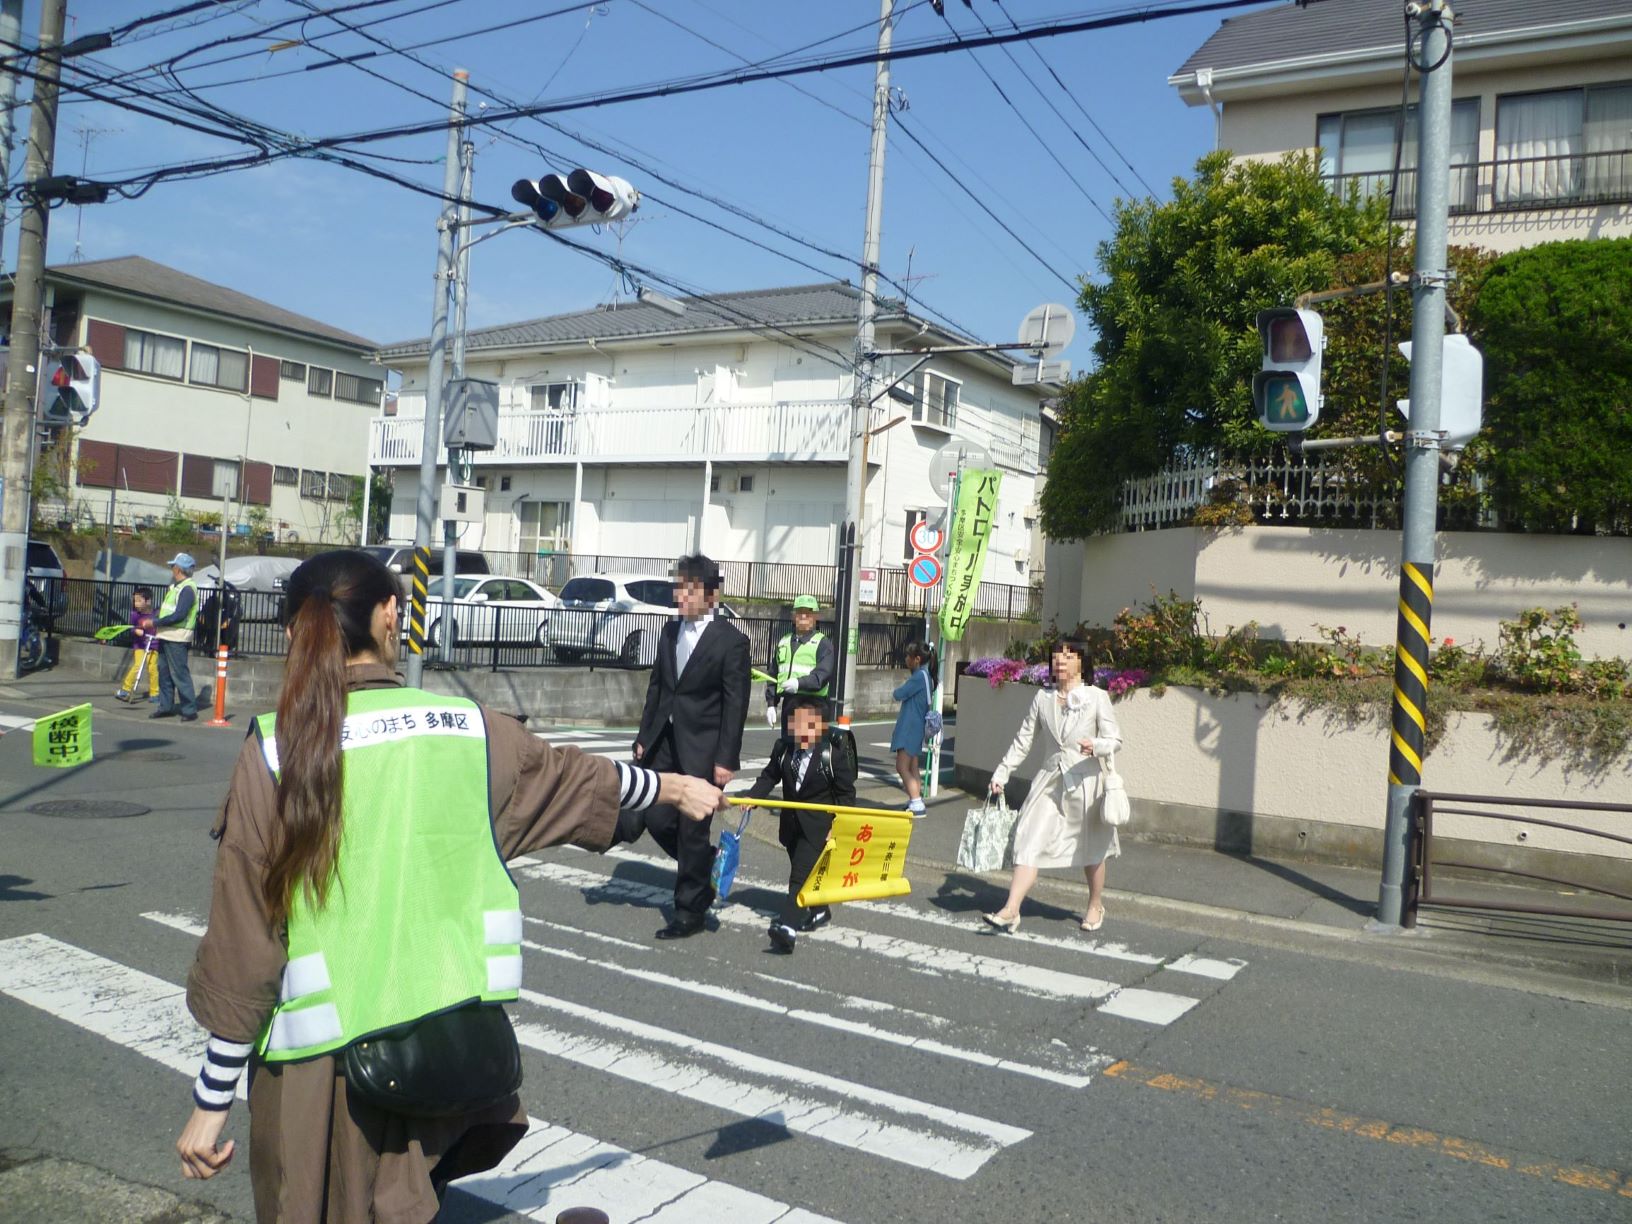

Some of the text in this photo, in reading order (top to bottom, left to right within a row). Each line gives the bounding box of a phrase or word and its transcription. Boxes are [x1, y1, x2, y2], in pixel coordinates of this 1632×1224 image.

[48, 715, 79, 758] 横断中
[425, 711, 469, 730] 多摩区
[841, 823, 874, 888] ありが
